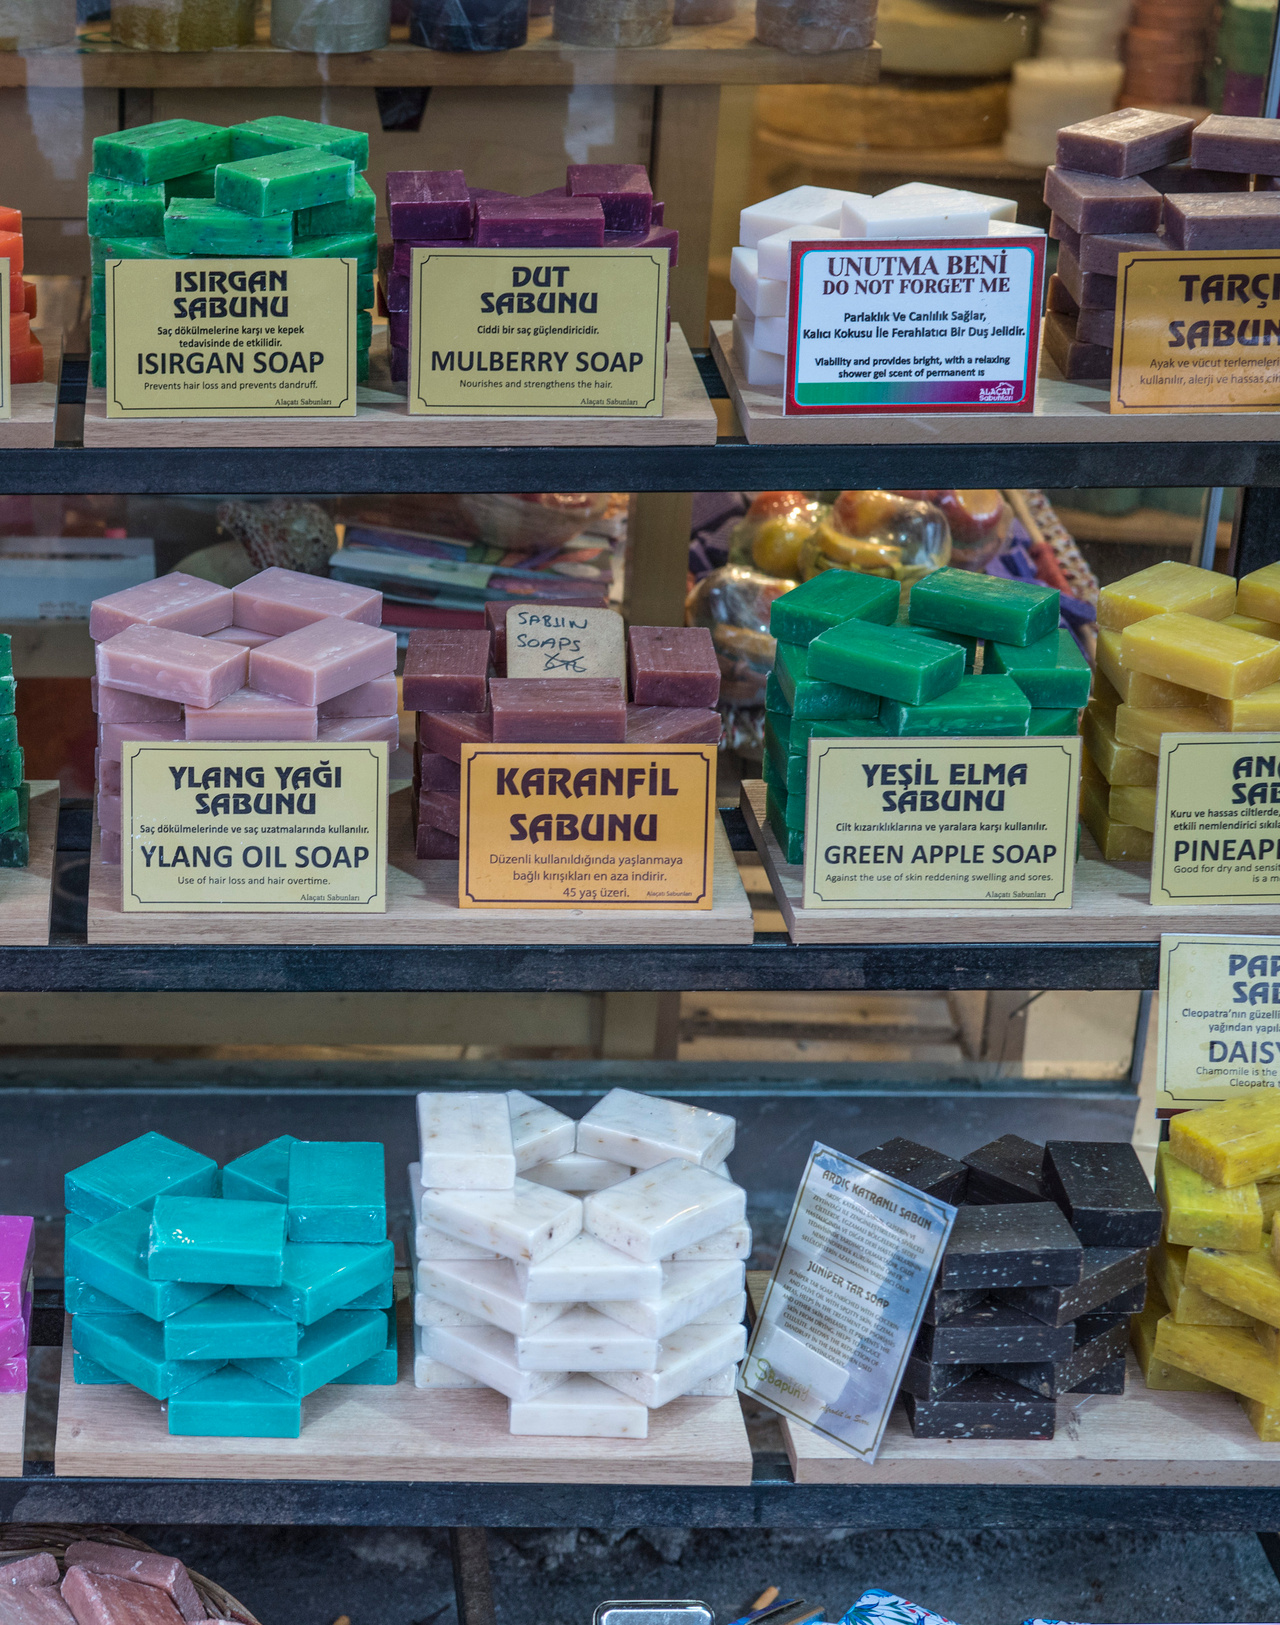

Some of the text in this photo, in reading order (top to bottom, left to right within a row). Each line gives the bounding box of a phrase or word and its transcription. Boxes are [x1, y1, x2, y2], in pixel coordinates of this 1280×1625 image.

[828, 248, 1007, 276] UNUTMA BENİ
[176, 271, 287, 294] ISIRGAN
[512, 267, 570, 287] DUT
[822, 277, 1010, 296] DO NOT FORGET ME
[174, 297, 288, 320] SABUNU
[481, 293, 597, 315] SABUNU
[843, 310, 987, 323] Parlaklık Ve Canlılık Sağlar,
[157, 324, 305, 338] Saç dökülmelerine karşı ve kepek
[477, 325, 600, 337] Ciddi bir saç güçlendiricidir.
[138, 352, 324, 374] ISIRGAN SOAP
[432, 351, 643, 372] MULBERRY SOAP
[1149, 357, 1176, 371] Ayak
[1177, 360, 1190, 368] ve
[1191, 357, 1222, 368] vücut
[459, 379, 613, 390] Nourishes and strengthens the hair.
[169, 760, 341, 790] YLANG YAĞI
[862, 759, 1027, 792] YEŞİL ELMA
[1233, 756, 1280, 780] AN
[497, 762, 678, 799] KARANFİL
[196, 793, 315, 817] SABUNU
[883, 788, 1004, 814] SABUNU
[1170, 809, 1192, 818] Kuru
[1194, 810, 1206, 818] ve
[1207, 808, 1239, 818] hassas
[139, 824, 370, 836] Saç dökülmelerinde ve saç uzatmalarında kullanılır.
[510, 814, 657, 844] SABUNU
[835, 822, 852, 832] Cilt
[924, 824, 937, 832] ve
[938, 822, 977, 833] yaralara
[979, 822, 1002, 833] karşı
[1004, 821, 1048, 831] kullanılır.
[141, 846, 369, 868] YLANG OIL SOAP
[489, 853, 683, 868] Düzenli kullanıldığında yaşlanmaya
[825, 845, 1056, 864] GREEN APPLE SOAP
[1175, 839, 1280, 861] PINEAP
[513, 870, 667, 884] bağlı kırışıkları en aza indirir.
[562, 887, 630, 902] 45 yaş üzeri.
[852, 1183, 898, 1214] KATRANLI
[899, 1207, 932, 1230] SABUN
[847, 1280, 864, 1298] TAR
[866, 1291, 889, 1308] SOAP
